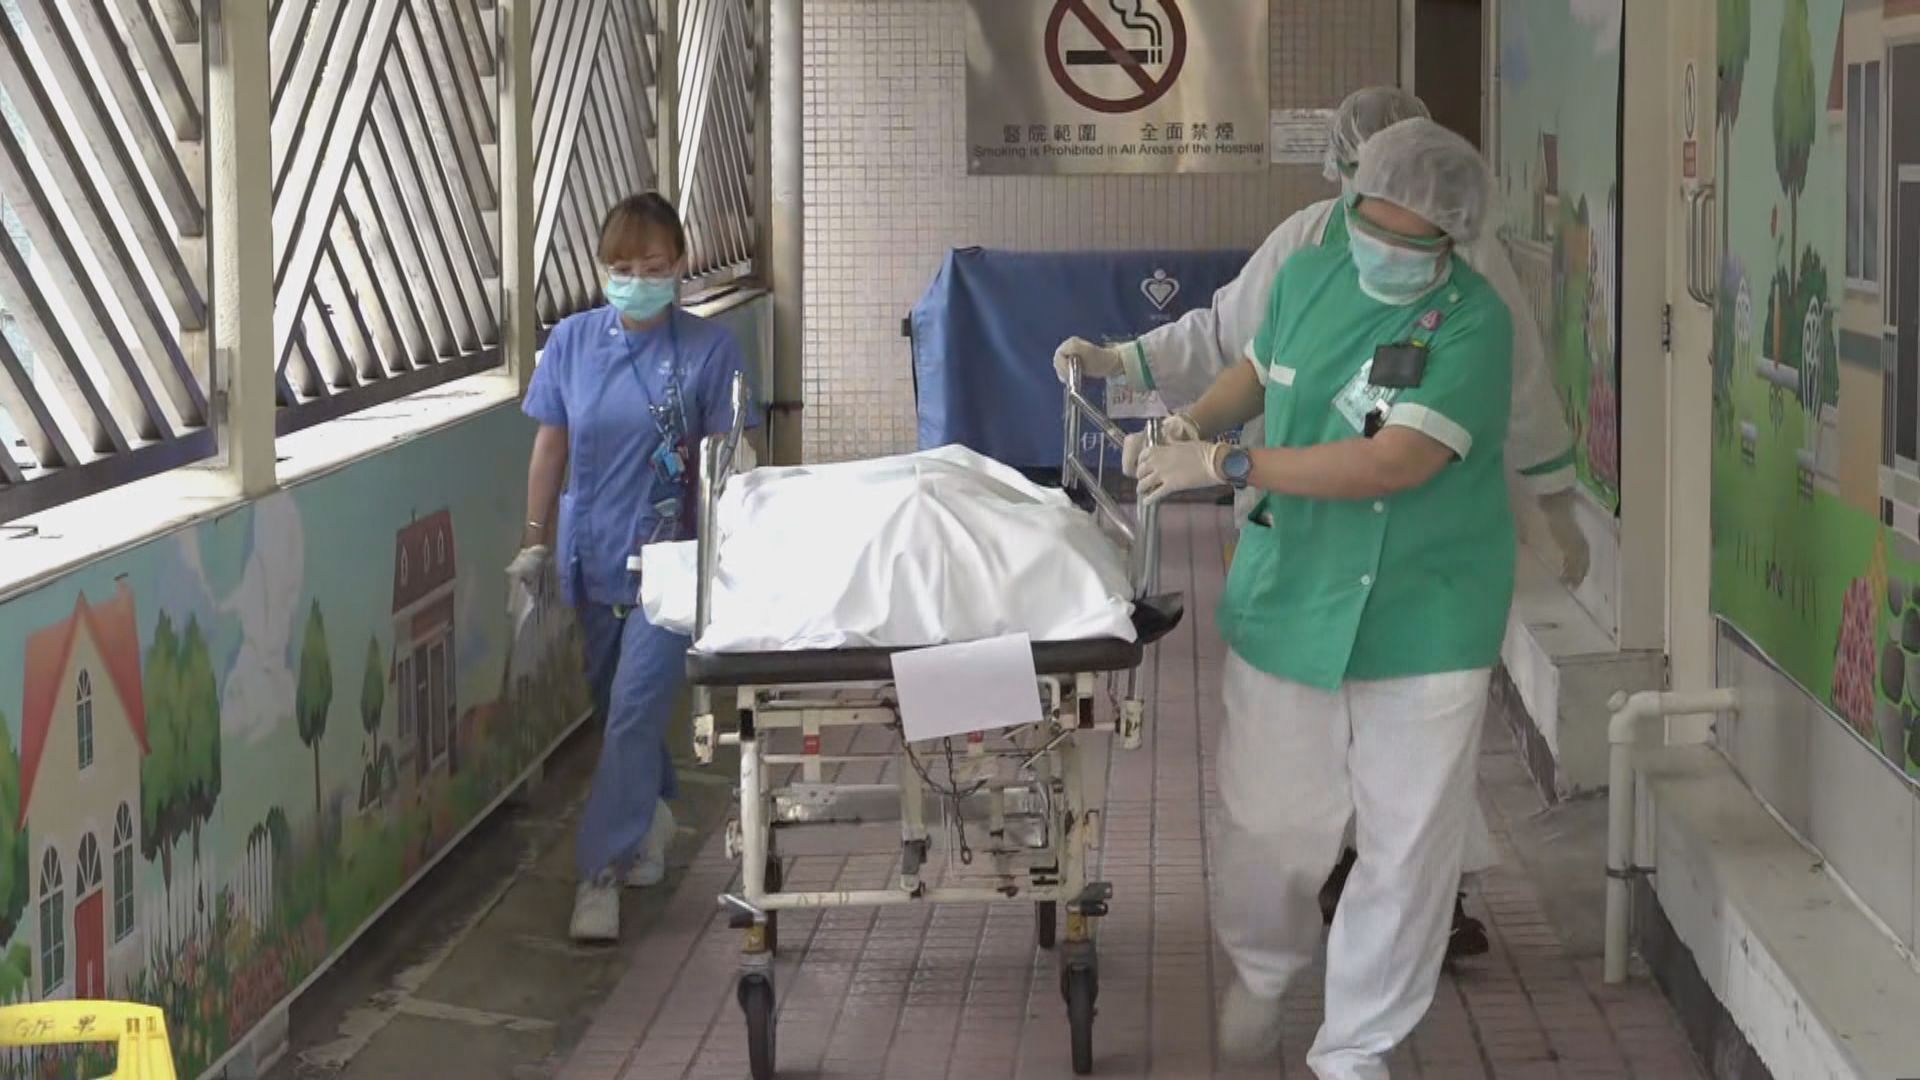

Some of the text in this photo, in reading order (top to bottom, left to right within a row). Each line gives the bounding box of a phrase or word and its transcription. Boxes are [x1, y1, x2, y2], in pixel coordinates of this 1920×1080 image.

[1003, 122, 1235, 143] 醫院範圍 全面禁煙
[974, 142, 1264, 158] Smoking is Prohibited in All Areas of the Hospital
